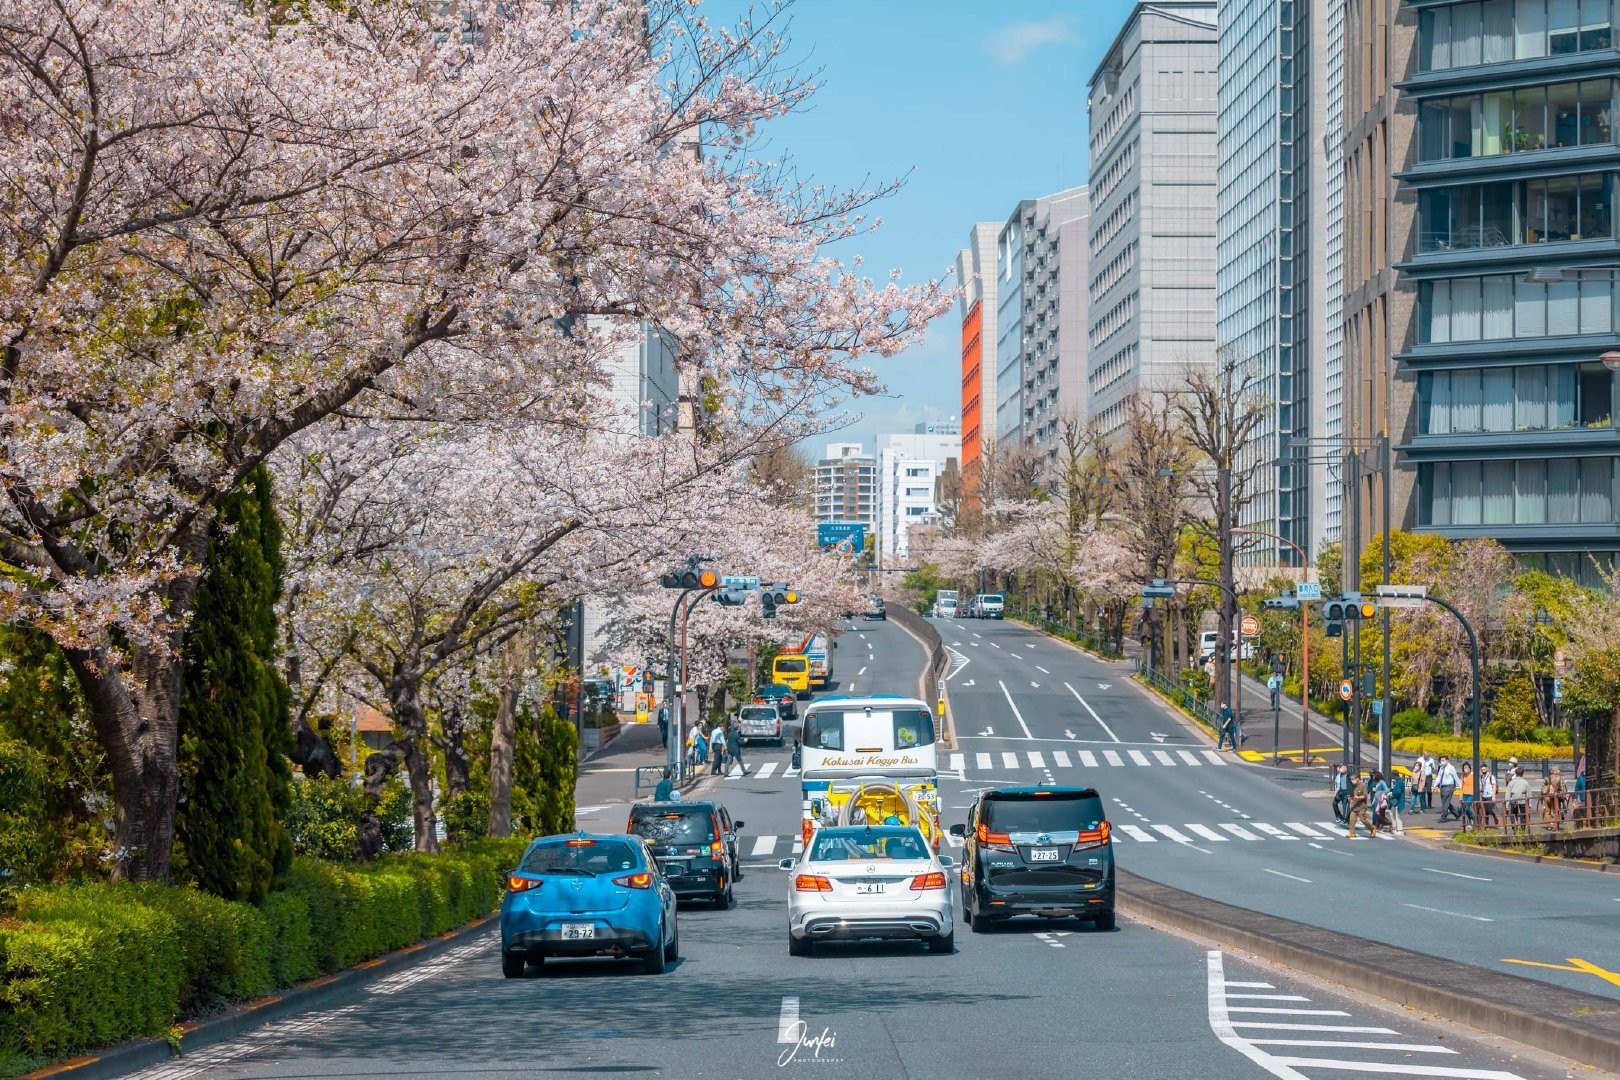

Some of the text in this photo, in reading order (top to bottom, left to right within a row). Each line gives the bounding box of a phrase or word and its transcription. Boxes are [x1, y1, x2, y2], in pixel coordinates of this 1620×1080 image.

[821, 755, 918, 767] Kokusai Kogyo Bus
[568, 930, 593, 938] 29-72
